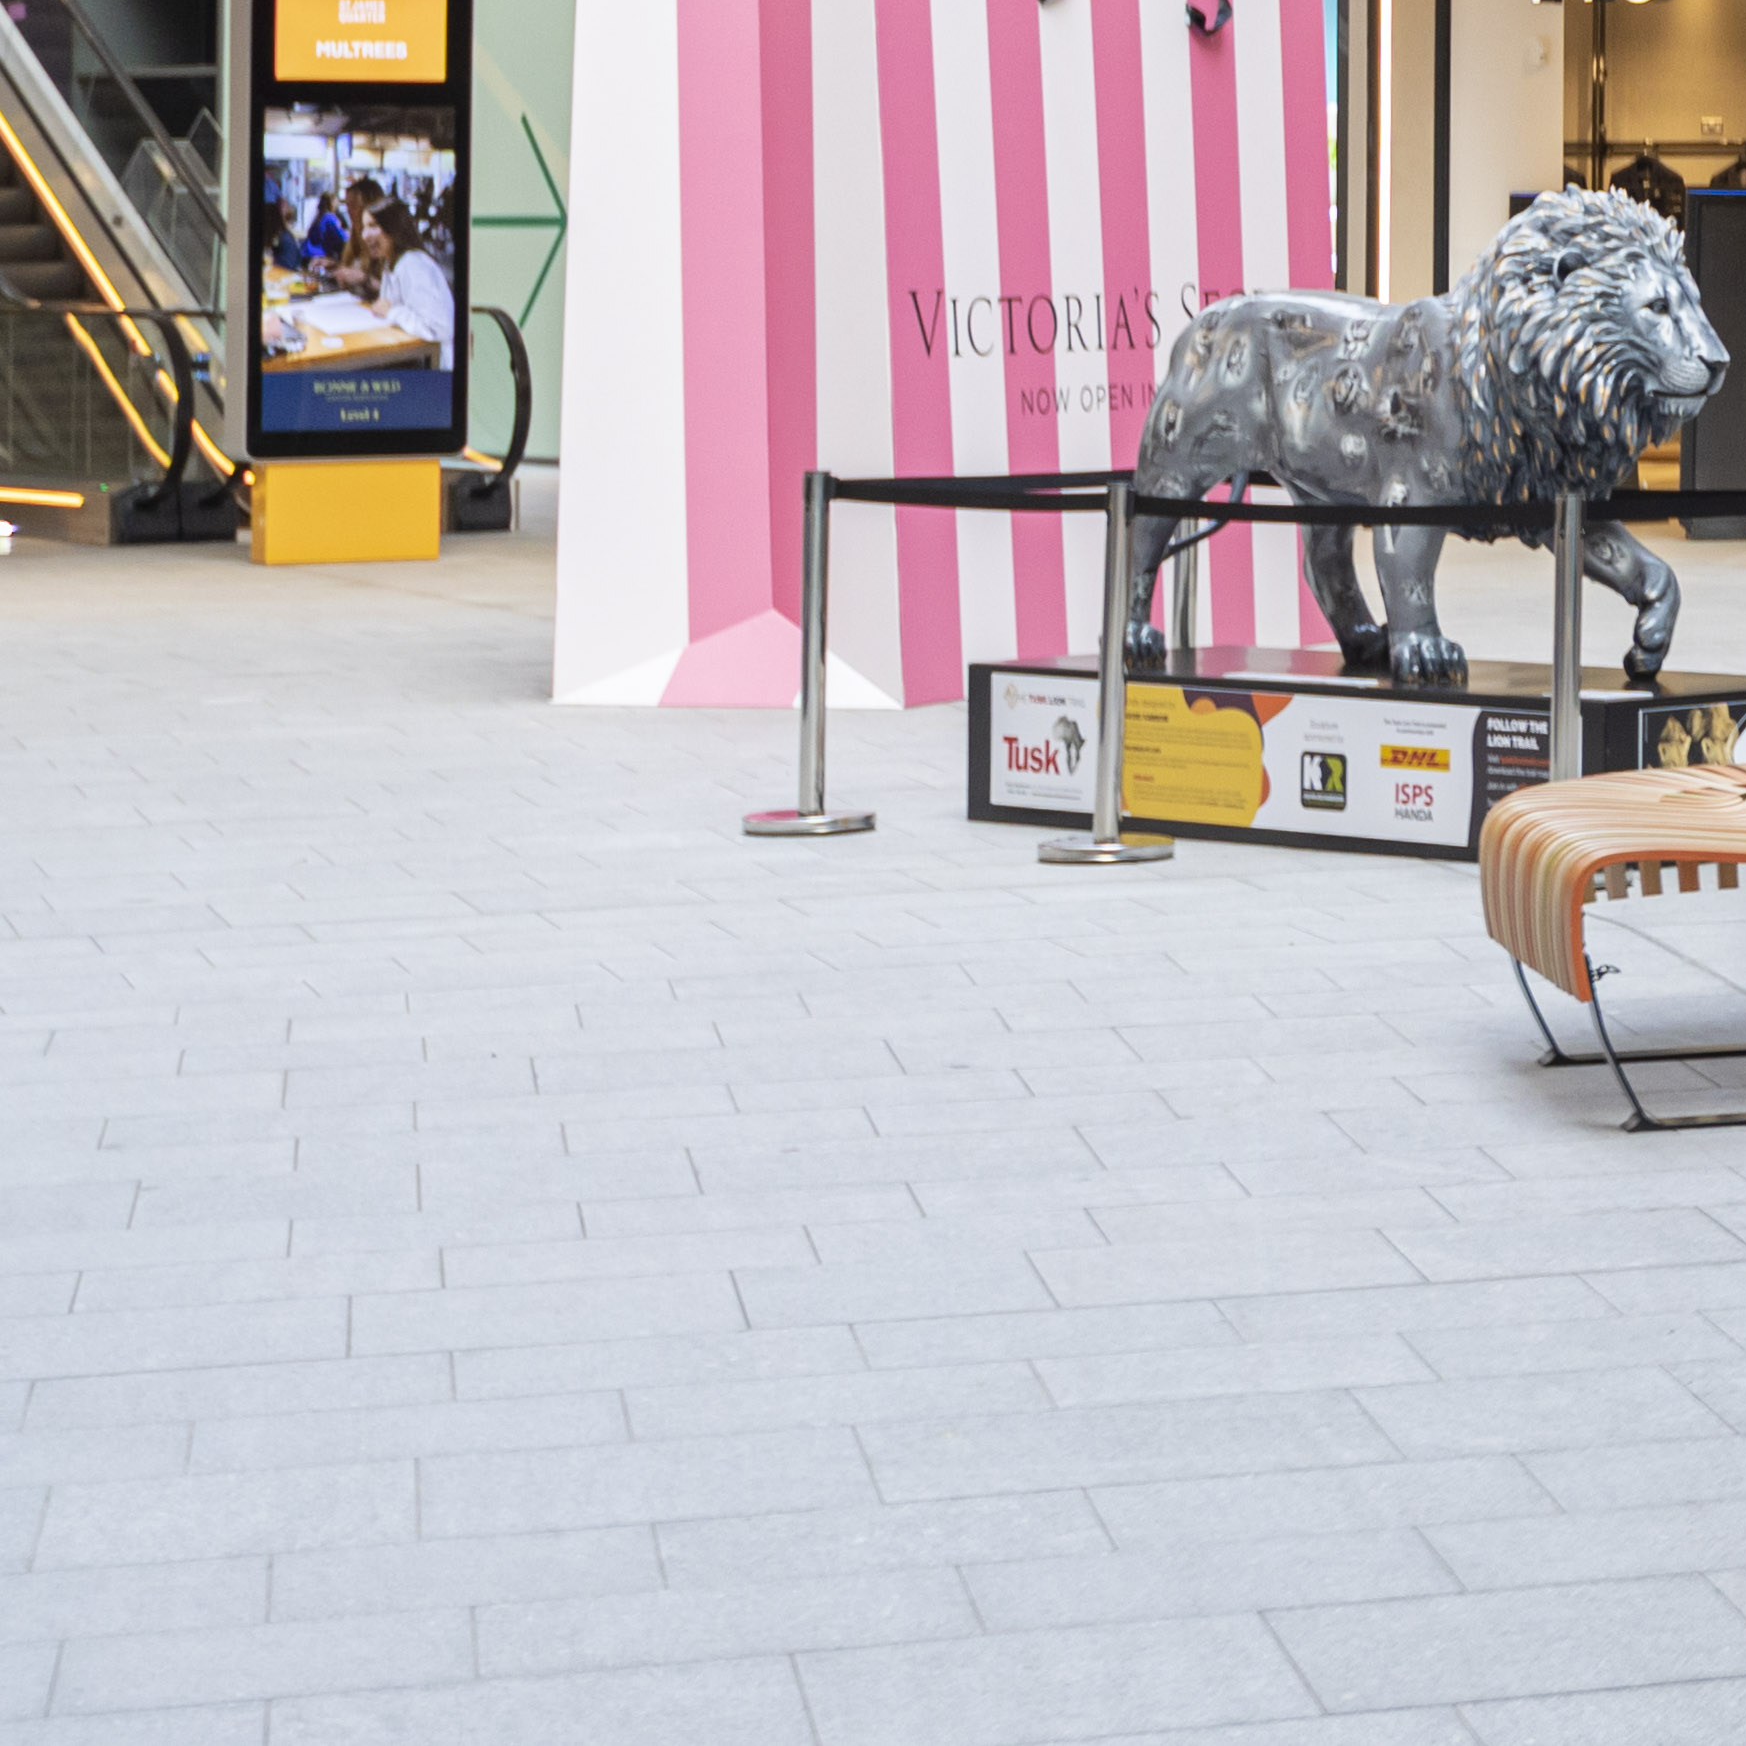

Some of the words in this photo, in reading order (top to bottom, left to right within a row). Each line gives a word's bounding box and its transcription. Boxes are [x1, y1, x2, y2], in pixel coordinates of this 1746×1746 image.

[316, 39, 408, 61] MULTREES
[909, 286, 1162, 359] VICTORIA'S
[1020, 386, 1071, 416] NOW
[1080, 383, 1133, 413] OPEN
[1486, 717, 1529, 733] FOLLOW
[1529, 719, 1549, 735] THE
[1486, 734, 1511, 748] LION
[1512, 735, 1540, 751] TRAIL
[1003, 736, 1060, 776] Tusk
[1390, 748, 1441, 768] DHL
[1395, 783, 1433, 808] ISPS
